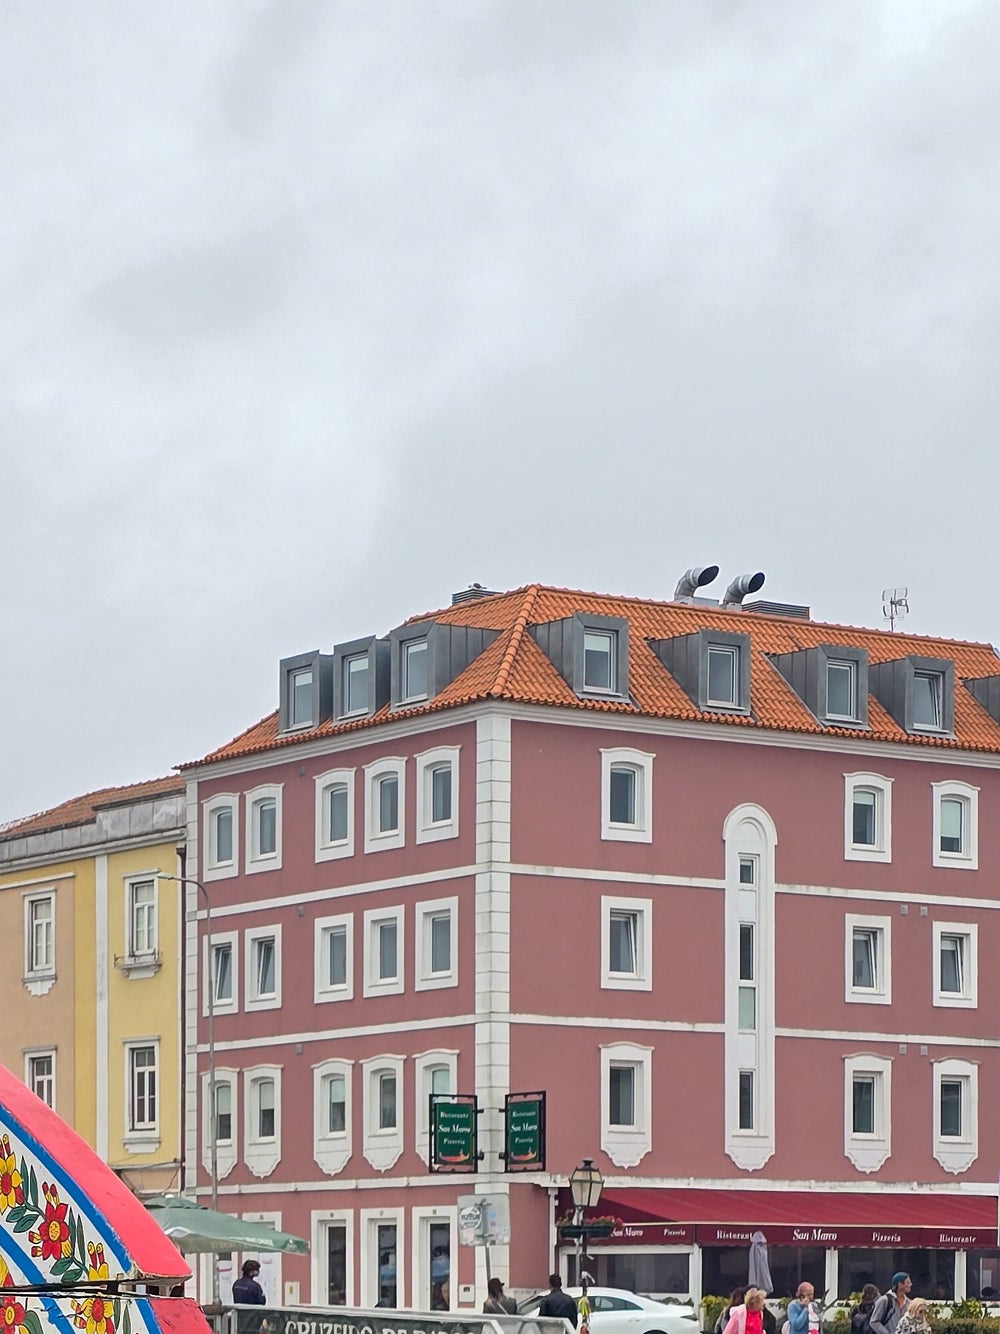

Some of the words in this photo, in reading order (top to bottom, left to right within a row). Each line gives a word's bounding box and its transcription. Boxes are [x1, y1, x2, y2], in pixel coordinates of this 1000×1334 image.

[439, 1124, 450, 1132] San
[452, 1124, 470, 1133] Marco
[624, 1227, 644, 1237] Marco
[716, 1230, 752, 1240] Ristorant
[793, 1229, 809, 1240] San
[811, 1229, 837, 1241] Marco
[872, 1232, 901, 1242] Pizzeria
[940, 1234, 976, 1243] Ristorante
